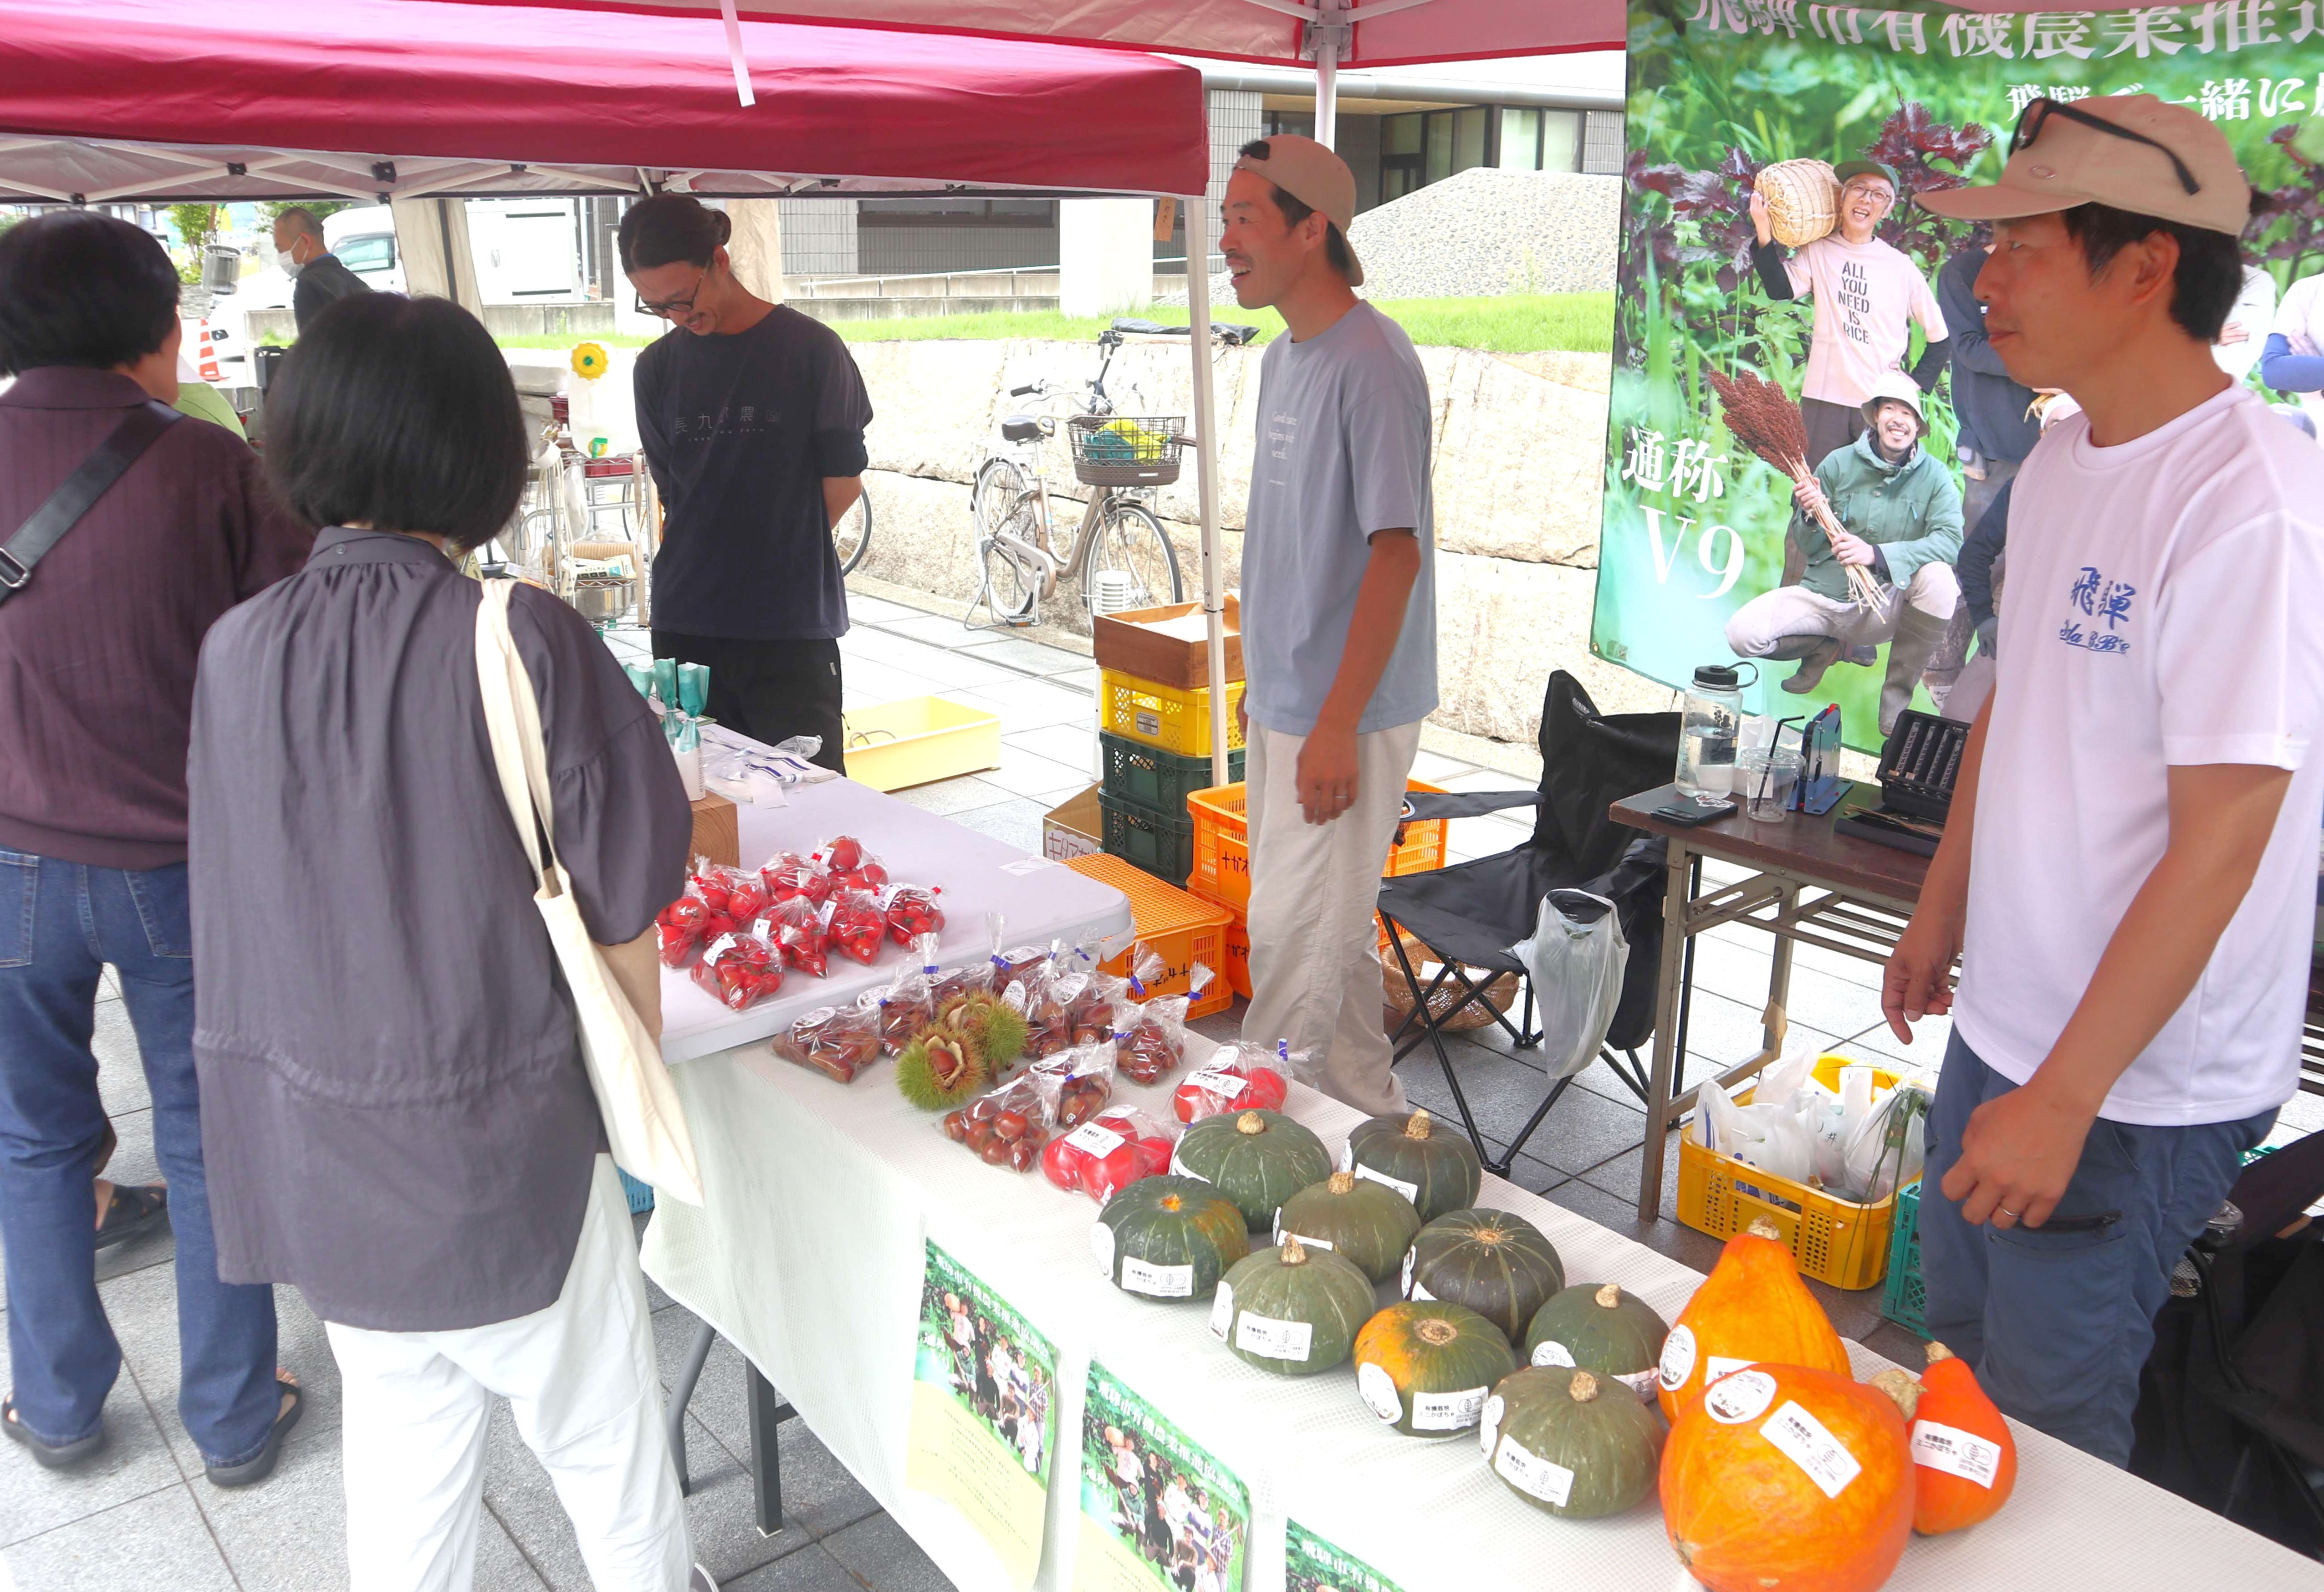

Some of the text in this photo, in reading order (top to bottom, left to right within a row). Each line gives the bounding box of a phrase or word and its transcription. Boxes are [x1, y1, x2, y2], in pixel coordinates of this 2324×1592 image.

[1686, 0, 2324, 59] 飛騨市有機農業推
[1842, 261, 1866, 280] ALL
[1841, 276, 1867, 296] YOU
[1838, 291, 1869, 313] NEED
[1849, 309, 1860, 326] IS
[1843, 321, 1869, 344] RICE
[1622, 426, 1729, 503] 通称
[1639, 505, 1745, 600] V9
[1226, 943, 1249, 964] ガオ
